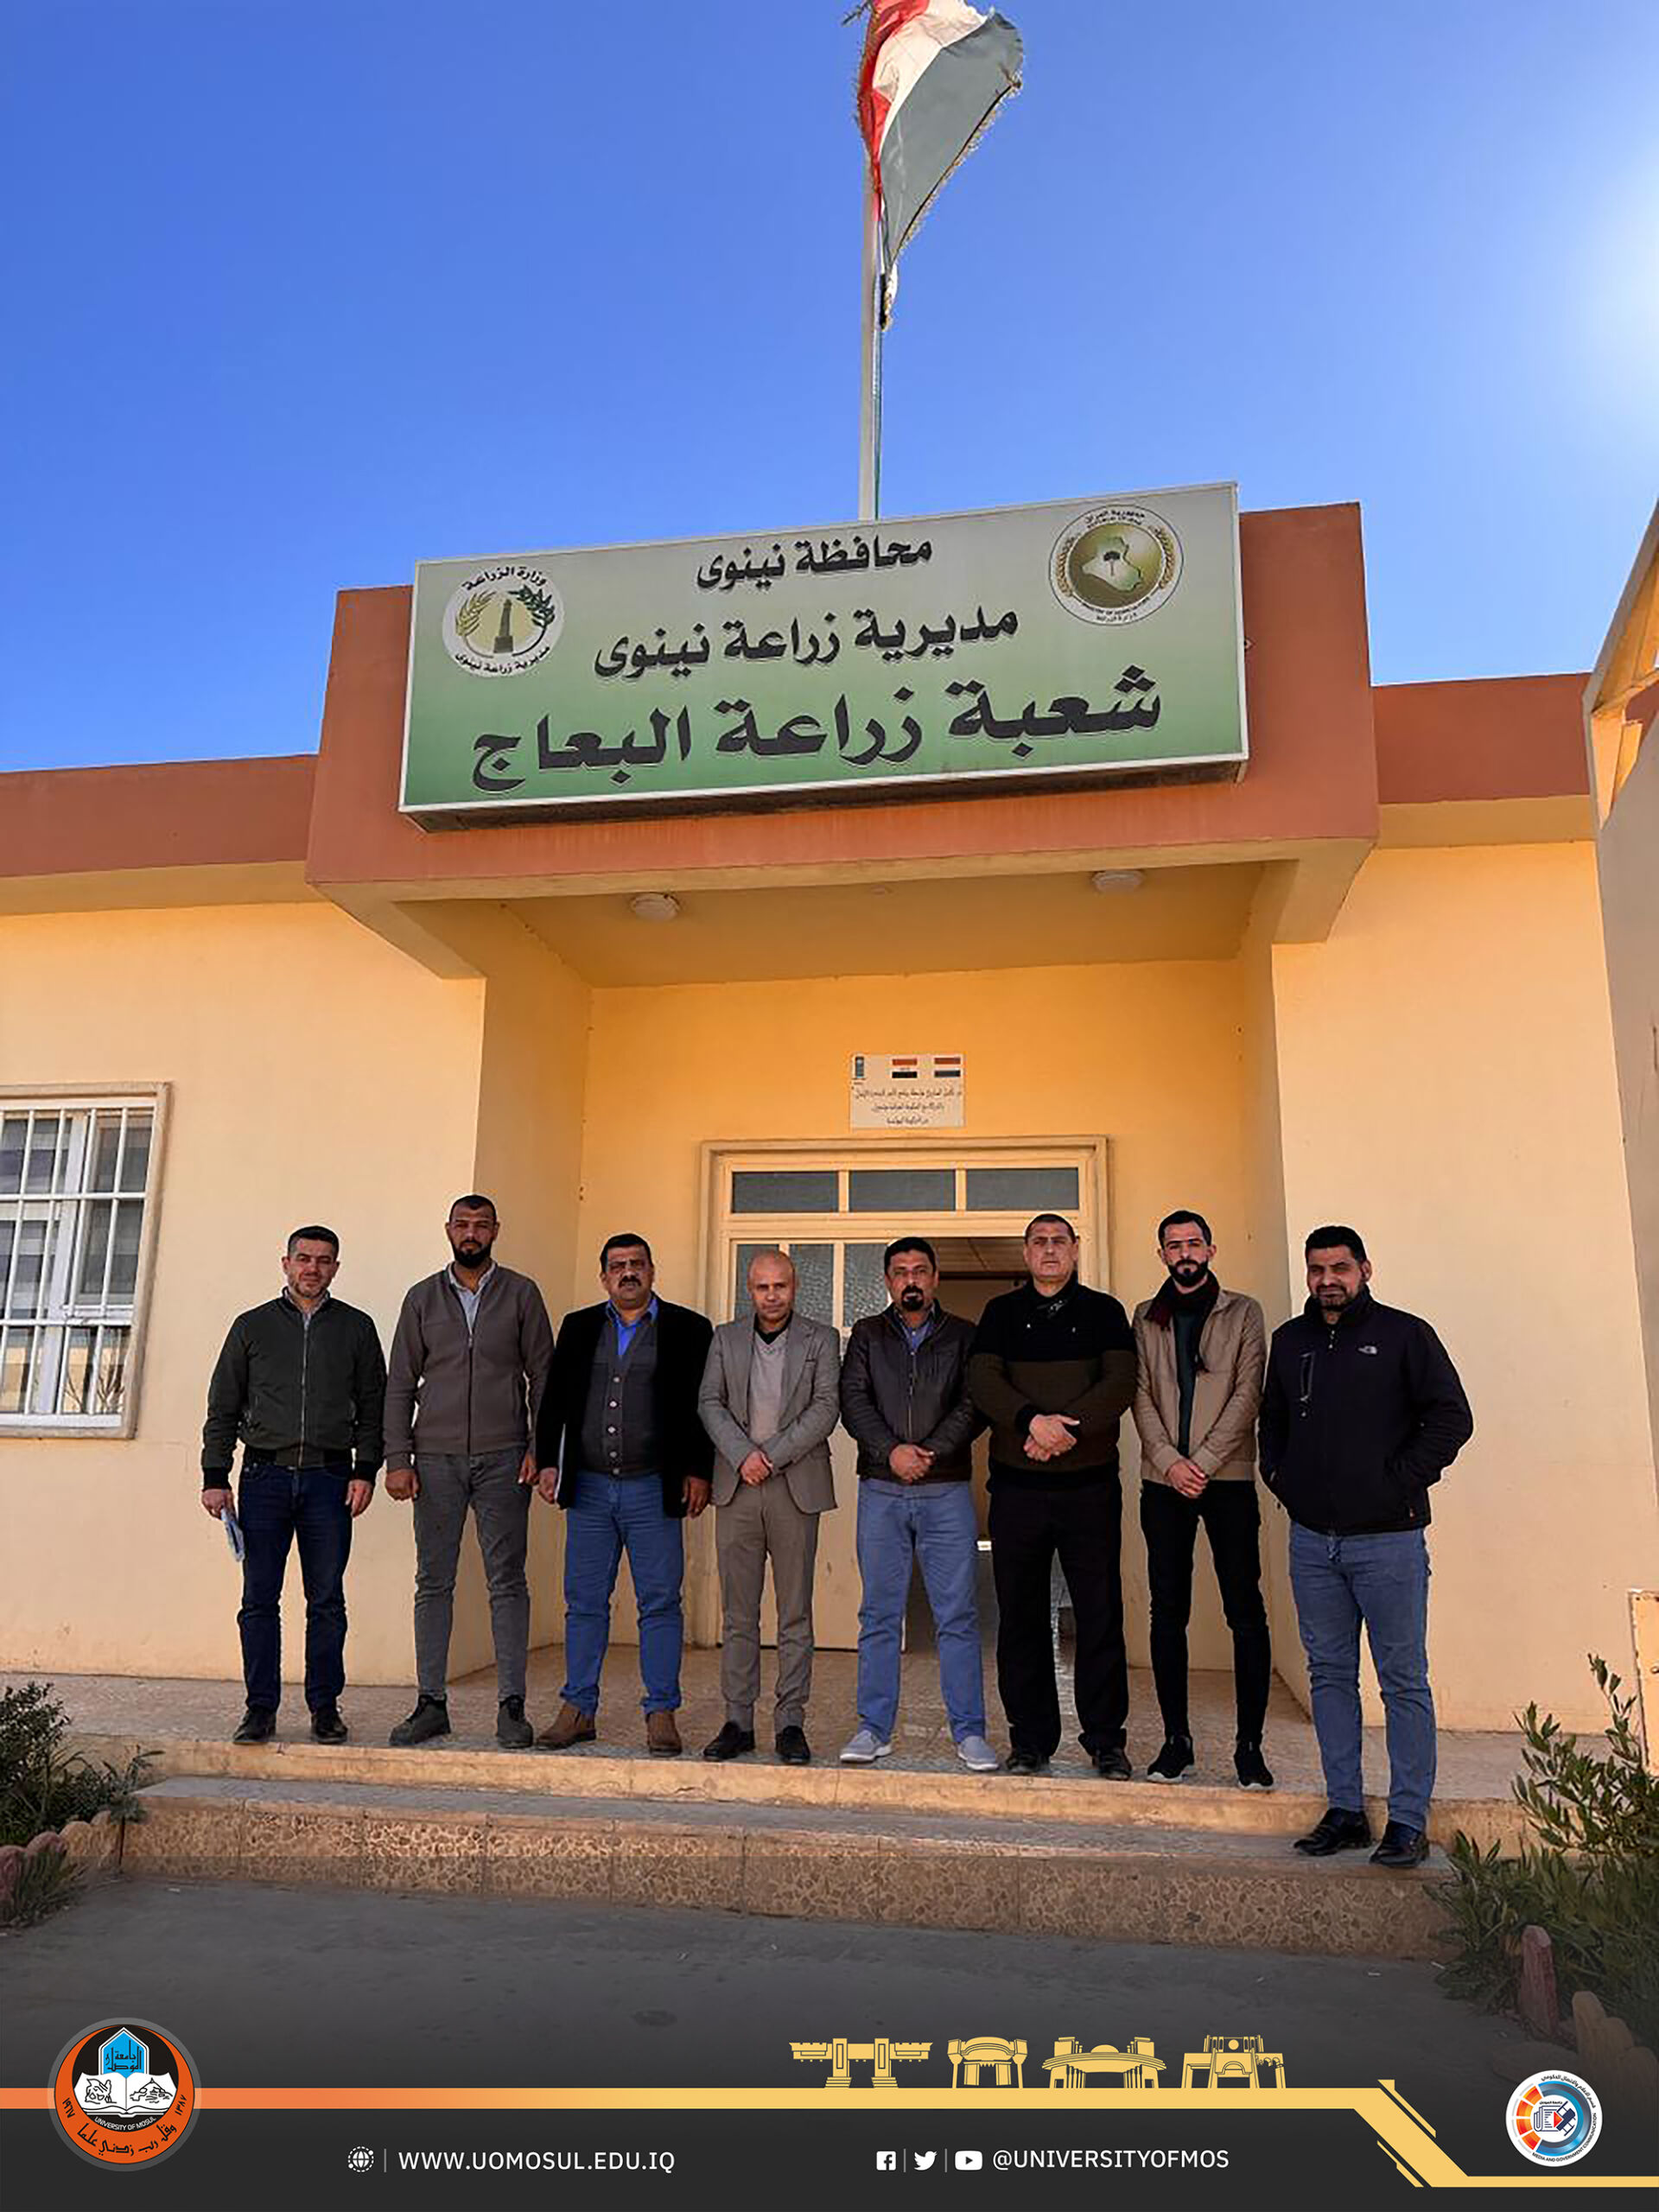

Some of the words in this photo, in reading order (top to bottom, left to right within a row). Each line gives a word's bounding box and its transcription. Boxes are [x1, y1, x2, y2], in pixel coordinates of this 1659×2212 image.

[517, 566, 547, 587] وزارة
[696, 543, 785, 590] نينوى
[795, 535, 932, 574] محافظة
[461, 566, 515, 591] الزراعة
[515, 645, 550, 669] مديرية
[594, 621, 710, 678] نينوى
[722, 612, 841, 665] زراعة
[853, 606, 1019, 661] مديرية
[454, 652, 481, 671] نينوى
[483, 663, 512, 675] زراعة
[714, 686, 923, 766] زراعة
[948, 664, 1161, 758] شعبة
[472, 705, 691, 792] البعاج
